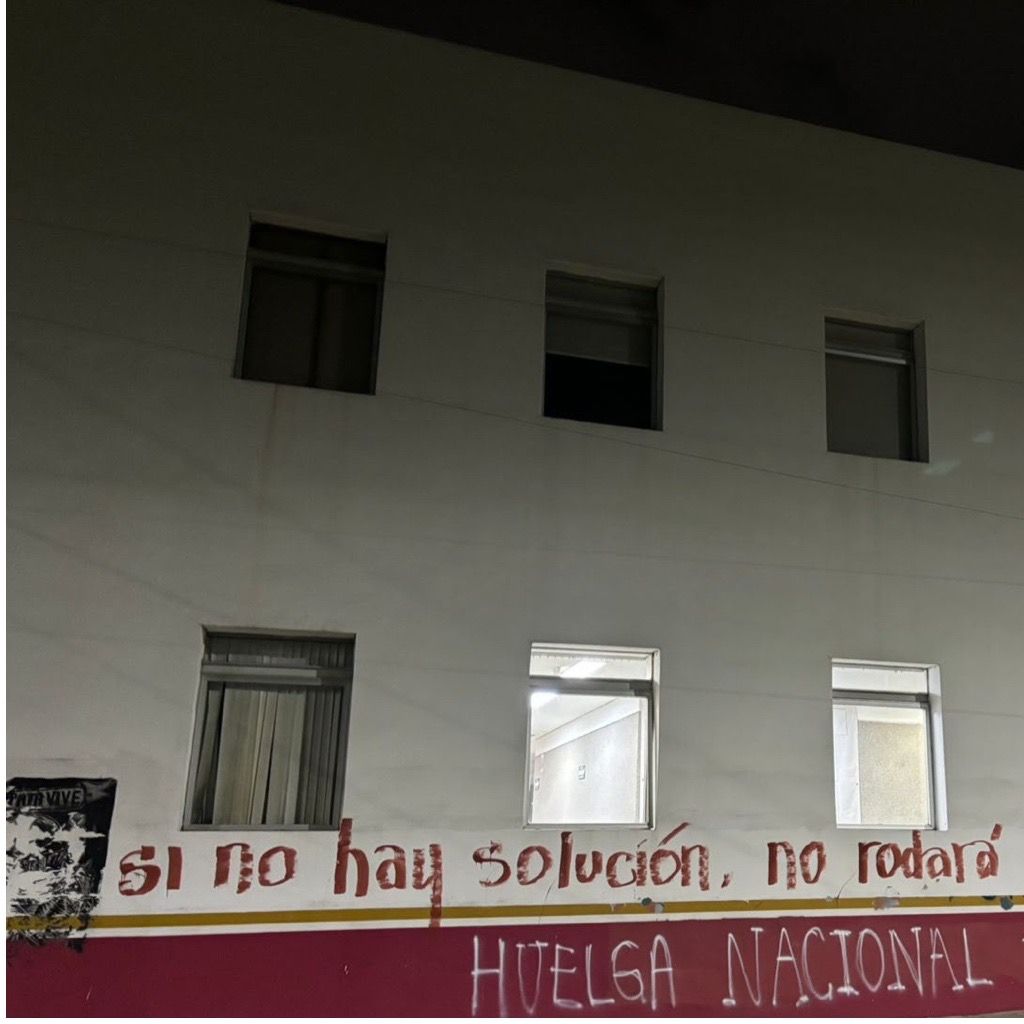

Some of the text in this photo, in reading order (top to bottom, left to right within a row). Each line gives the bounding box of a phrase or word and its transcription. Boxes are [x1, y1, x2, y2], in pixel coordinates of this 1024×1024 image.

[213, 842, 298, 894] no
[334, 818, 443, 930] hay
[767, 840, 826, 890] no
[858, 823, 1003, 884] rodará
[471, 925, 994, 1017] HUELGA NACIONAL
